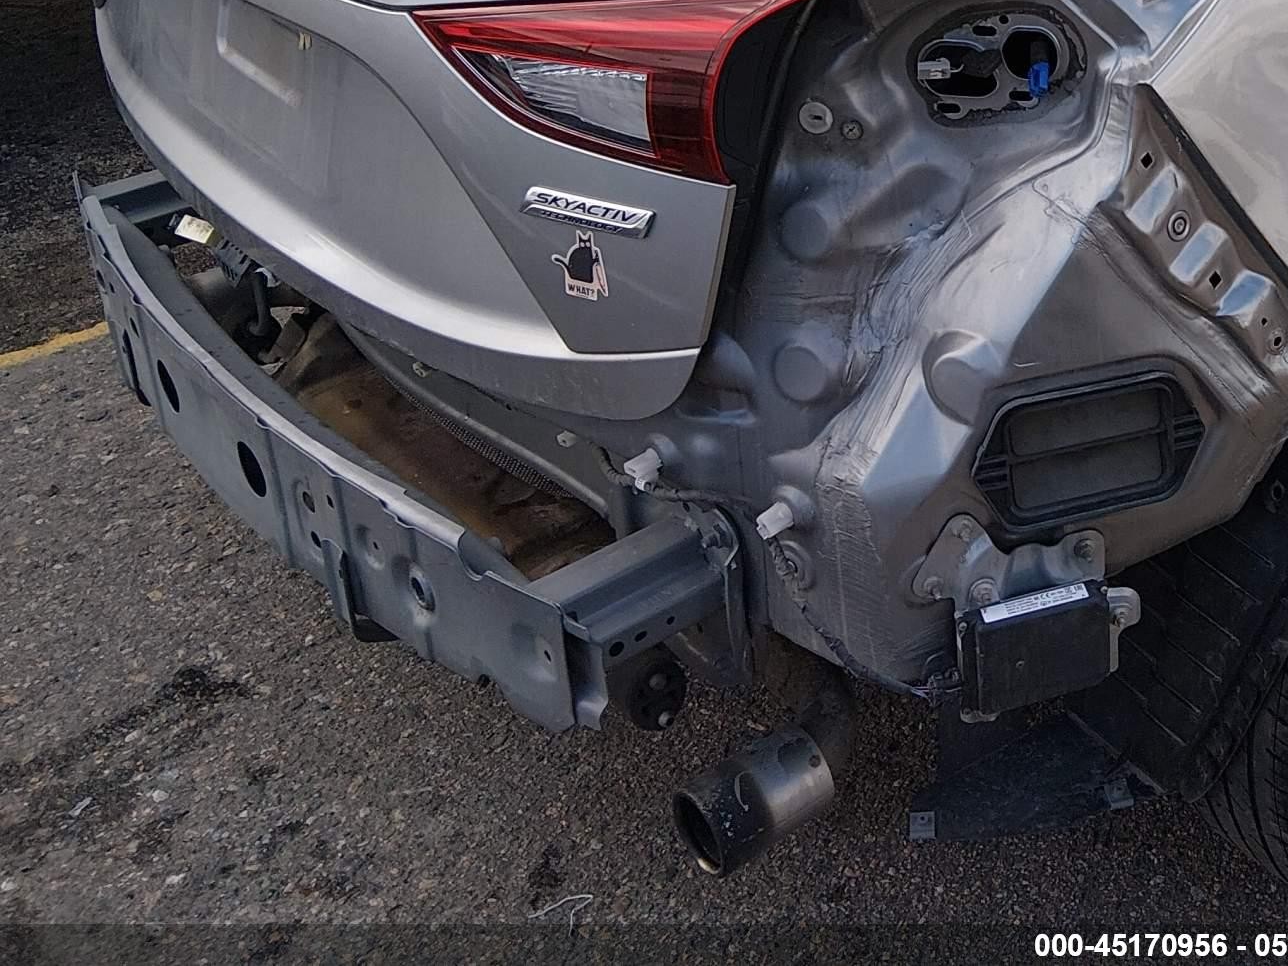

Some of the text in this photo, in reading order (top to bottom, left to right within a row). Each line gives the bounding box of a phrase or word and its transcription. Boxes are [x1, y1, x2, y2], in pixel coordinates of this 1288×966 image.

[534, 192, 637, 222] SKYACTIV
[540, 211, 624, 233] TECHNOLOGY
[568, 283, 595, 296] WHAT?
